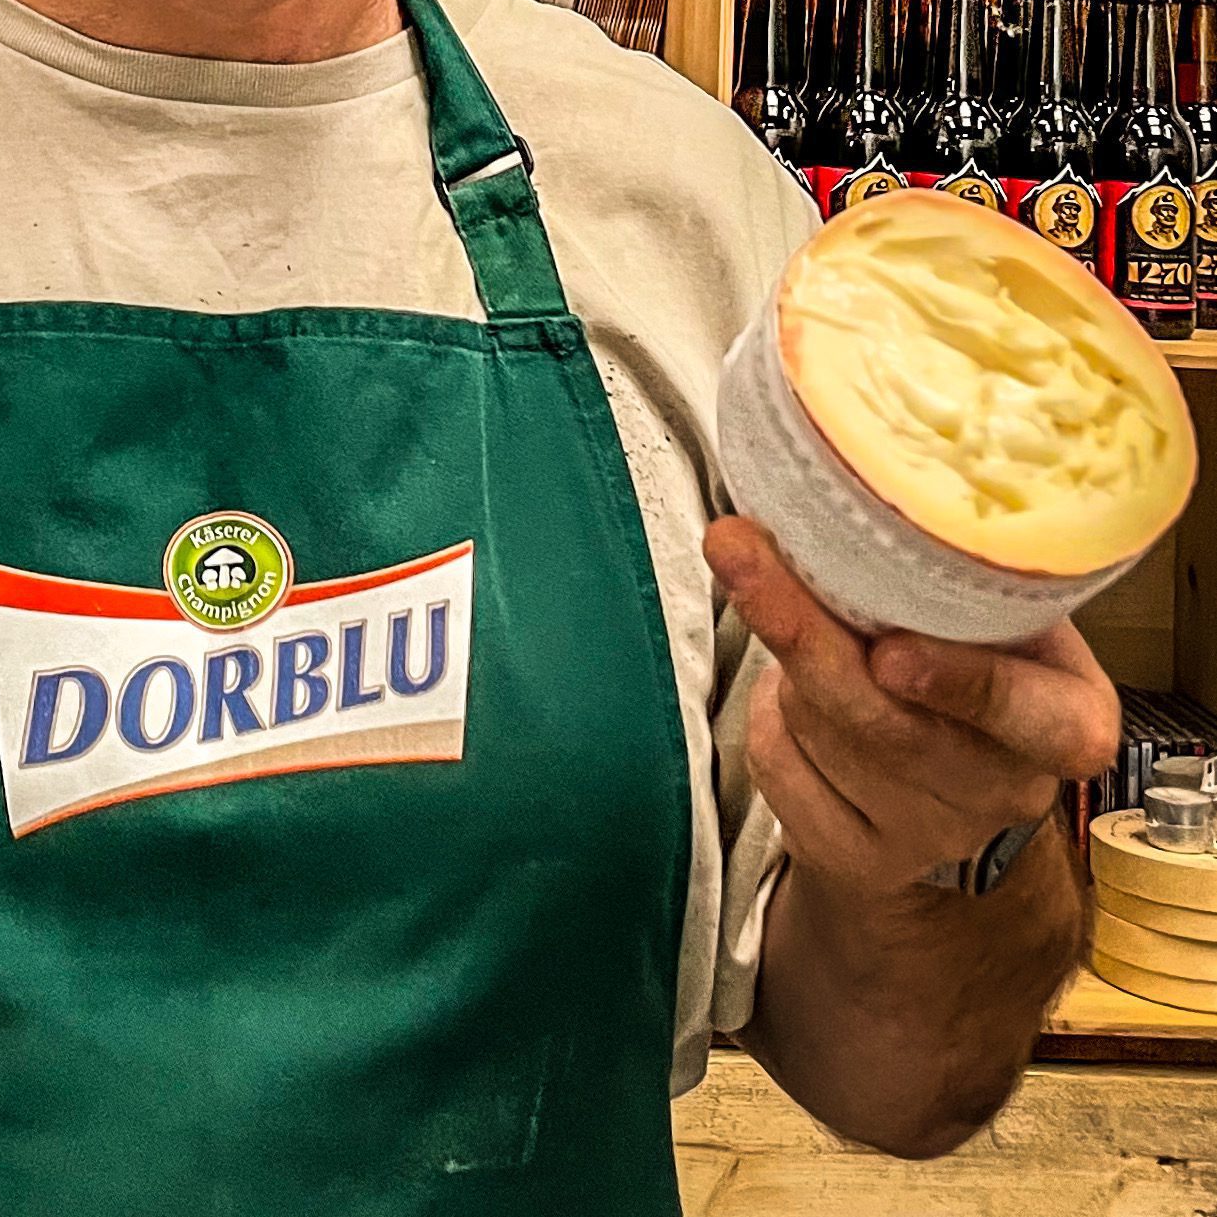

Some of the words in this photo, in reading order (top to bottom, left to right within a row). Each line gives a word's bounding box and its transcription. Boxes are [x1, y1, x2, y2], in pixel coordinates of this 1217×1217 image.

[189, 524, 261, 549] Käserei
[177, 570, 278, 623] Champignon
[18, 598, 450, 769] DORBLU
